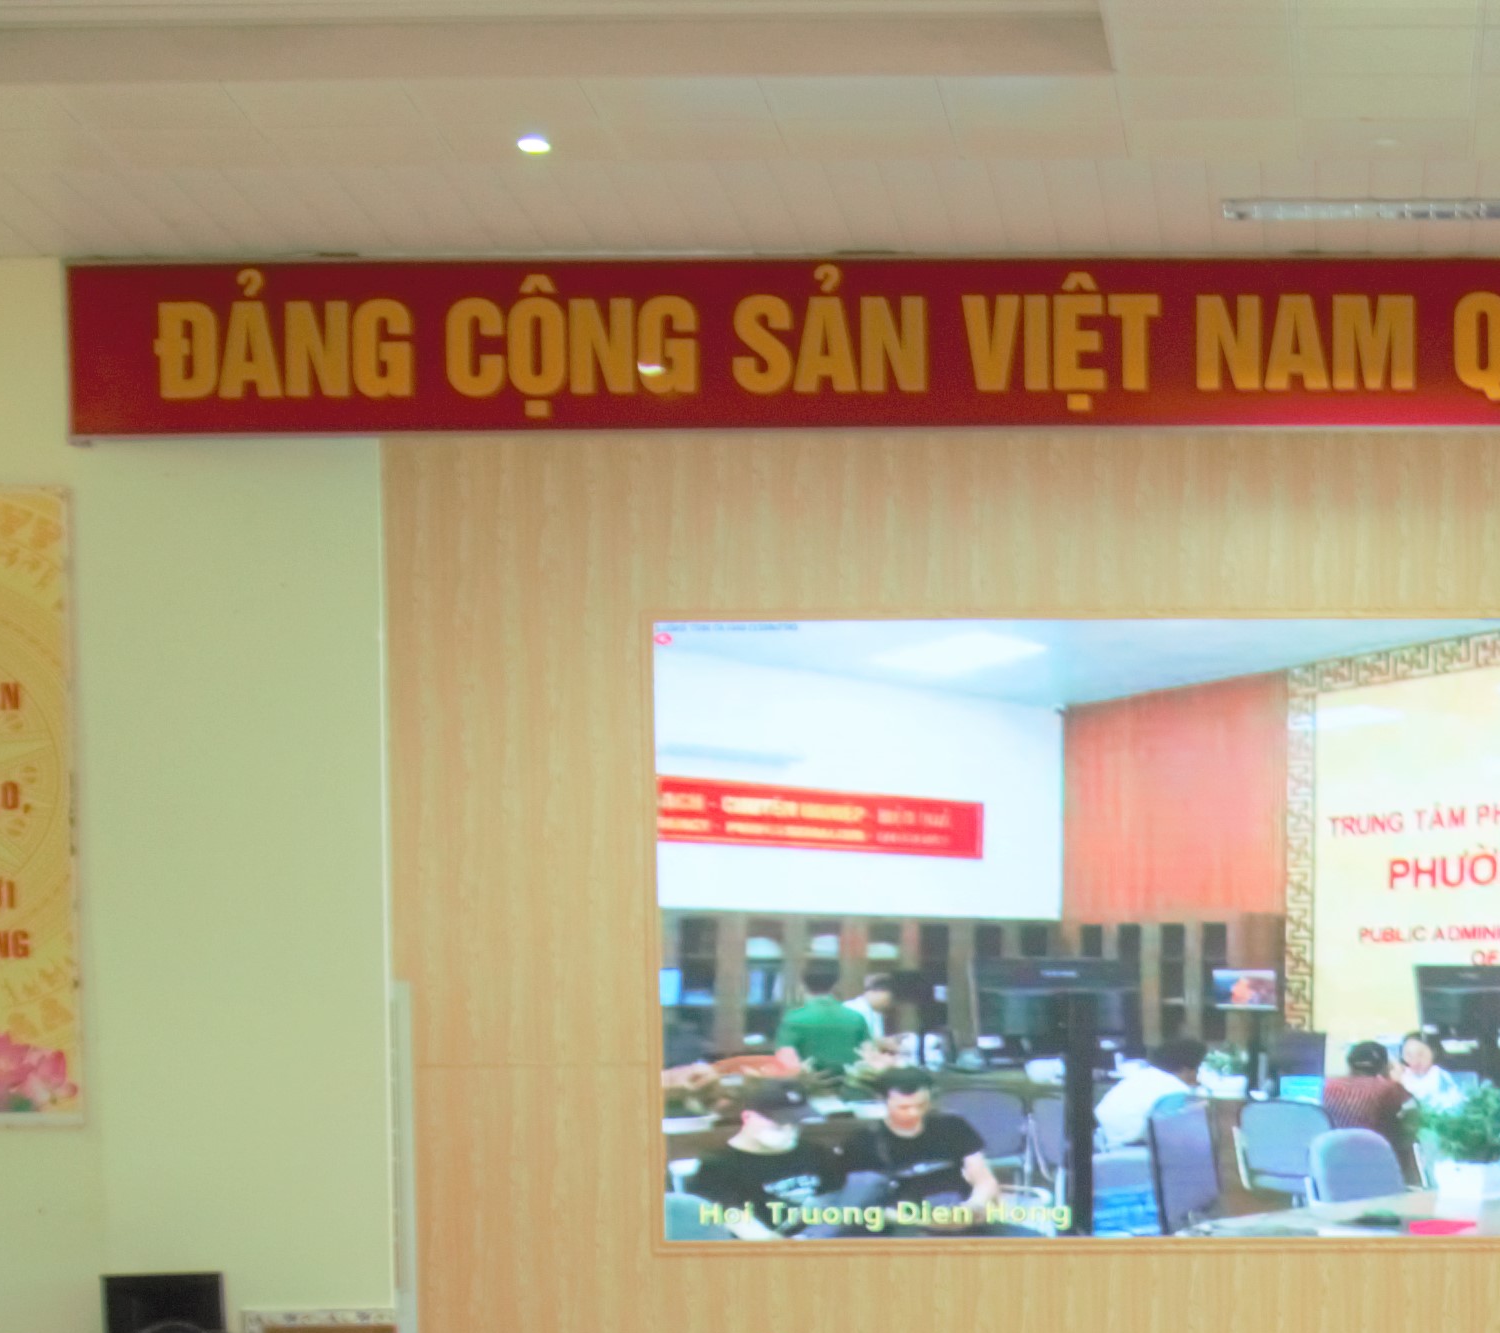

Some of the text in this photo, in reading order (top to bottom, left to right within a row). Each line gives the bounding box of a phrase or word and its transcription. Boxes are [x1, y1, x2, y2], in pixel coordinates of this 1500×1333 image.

[155, 268, 414, 399] ĐẢNG
[445, 273, 697, 418] CỘNG
[732, 264, 927, 395] SẢN
[962, 271, 1161, 412] VIỆT
[1195, 294, 1417, 392] NAM
[1328, 812, 1404, 838] TRUNG
[1414, 801, 1467, 830] TÂM
[1358, 925, 1428, 945] PUBLIC
[699, 1200, 1073, 1233] Hoi Truong Dien Hong
